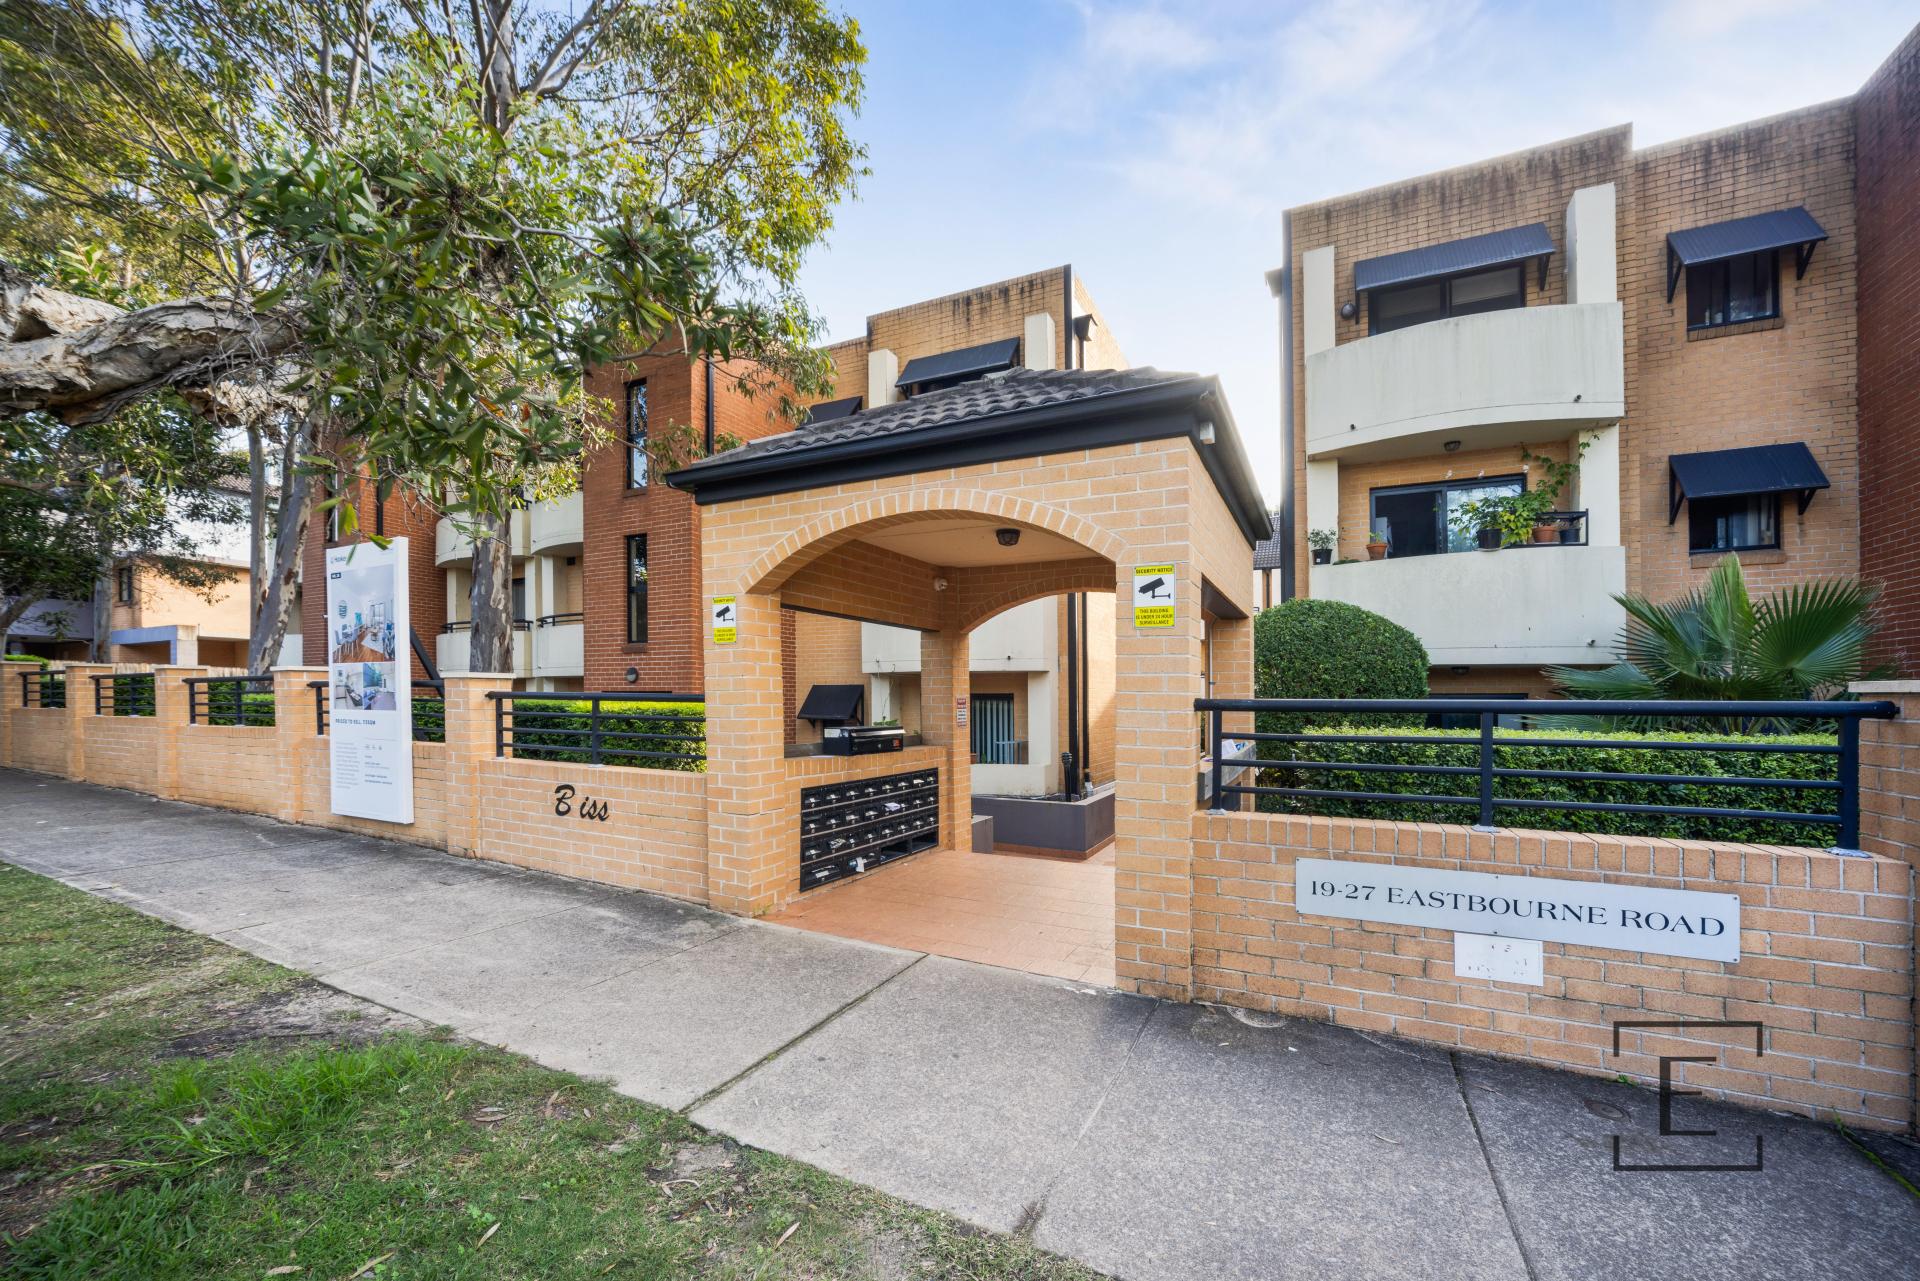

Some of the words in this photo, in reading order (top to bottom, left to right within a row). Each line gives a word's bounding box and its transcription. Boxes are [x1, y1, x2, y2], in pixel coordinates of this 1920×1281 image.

[1311, 880, 1376, 901] 19-27
[1387, 886, 1607, 925] EASTBOURNE
[1620, 908, 1725, 937] ROAD
